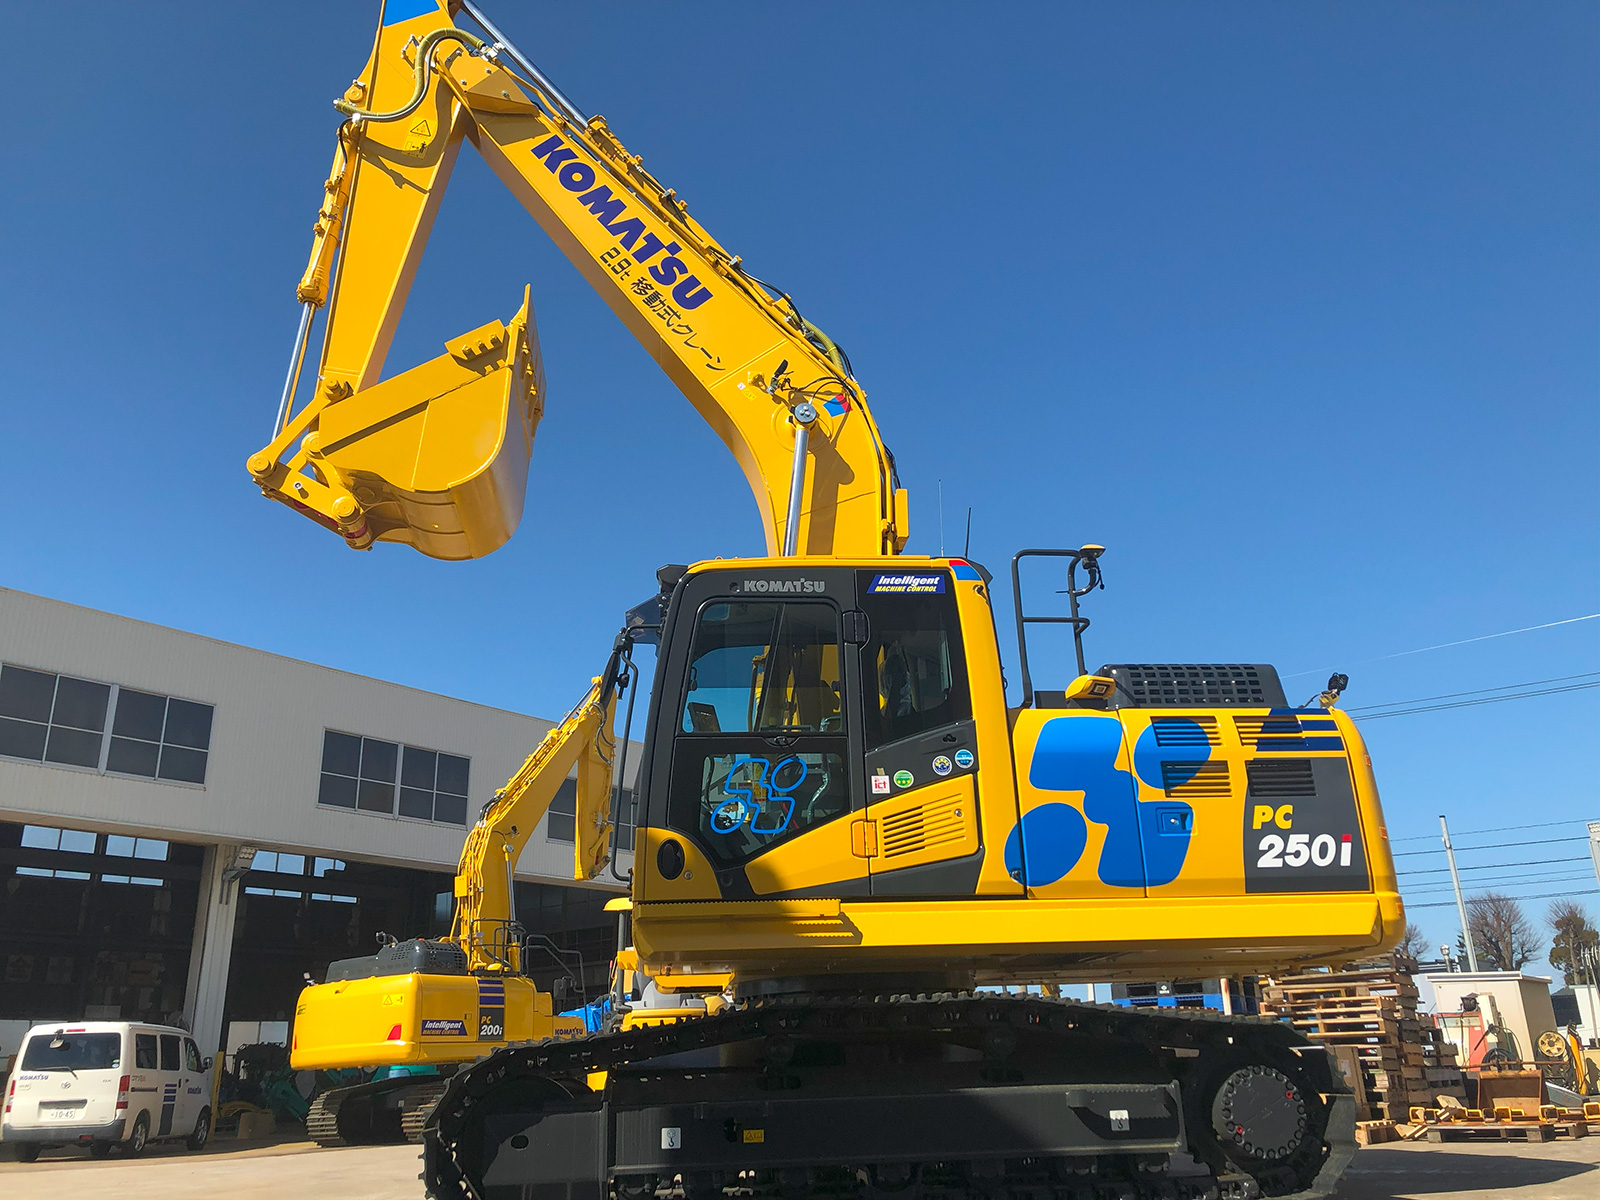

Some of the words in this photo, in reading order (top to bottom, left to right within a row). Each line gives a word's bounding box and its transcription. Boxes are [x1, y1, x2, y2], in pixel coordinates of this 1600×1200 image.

[530, 134, 714, 311] KOMATSU
[599, 246, 632, 281] 2.9t
[630, 276, 726, 371] 移動式クレーン
[743, 577, 825, 593] KOMATSU
[1252, 804, 1294, 830] PC
[1257, 833, 1352, 868] 250i
[480, 1025, 503, 1036] 200i
[481, 1016, 491, 1024] PC
